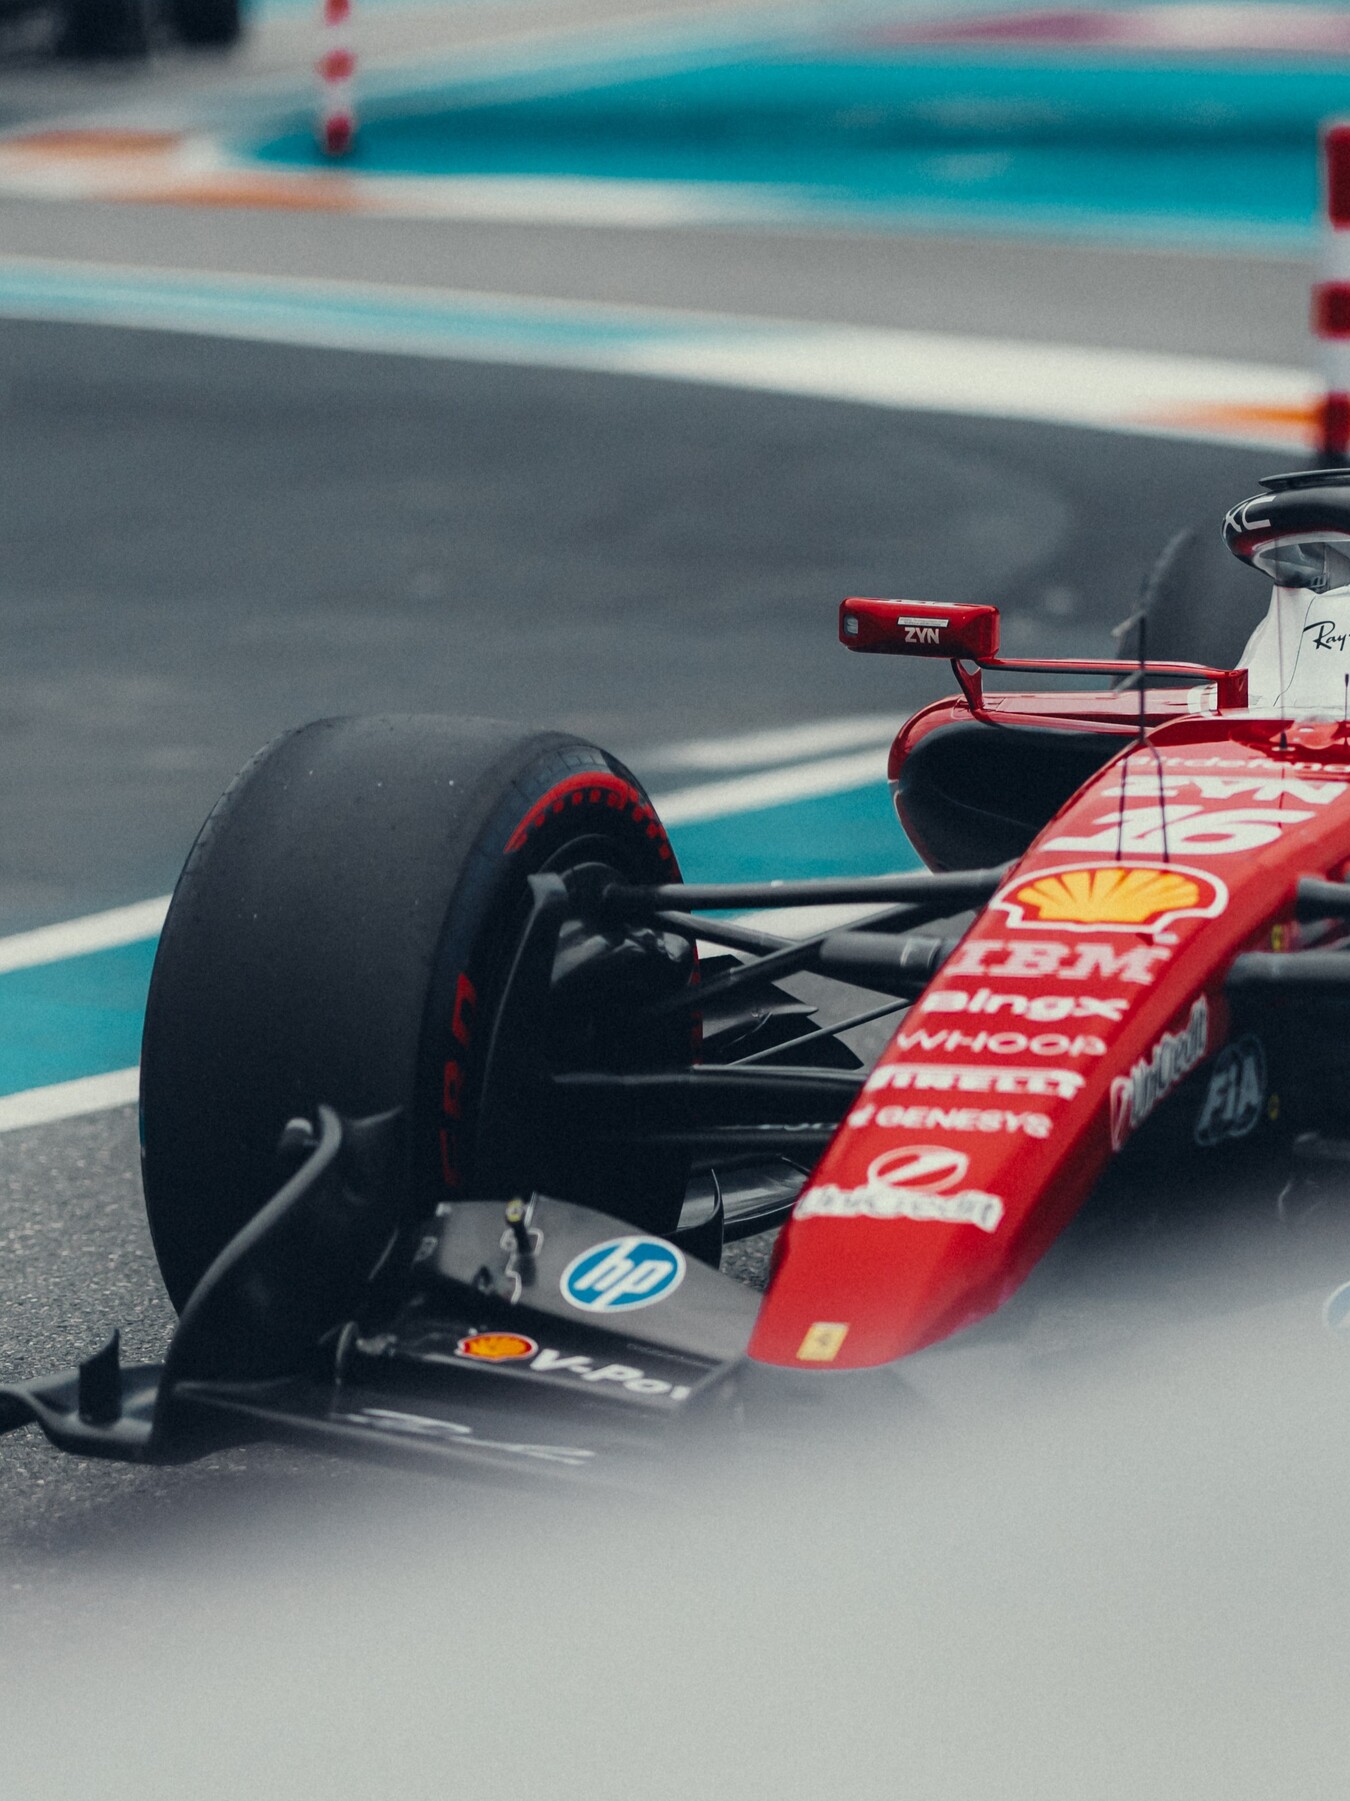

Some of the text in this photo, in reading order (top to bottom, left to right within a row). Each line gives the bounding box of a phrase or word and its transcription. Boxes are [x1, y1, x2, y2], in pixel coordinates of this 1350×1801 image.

[1222, 492, 1277, 534] XC
[904, 626, 940, 644] ZYN
[1101, 774, 1348, 805] ZYN
[1039, 803, 1316, 855] 16
[943, 939, 1171, 985] IBM
[896, 1029, 1108, 1057] WHOOP
[1199, 1055, 1262, 1131] FIA
[875, 1104, 1053, 1139] GENESYS
